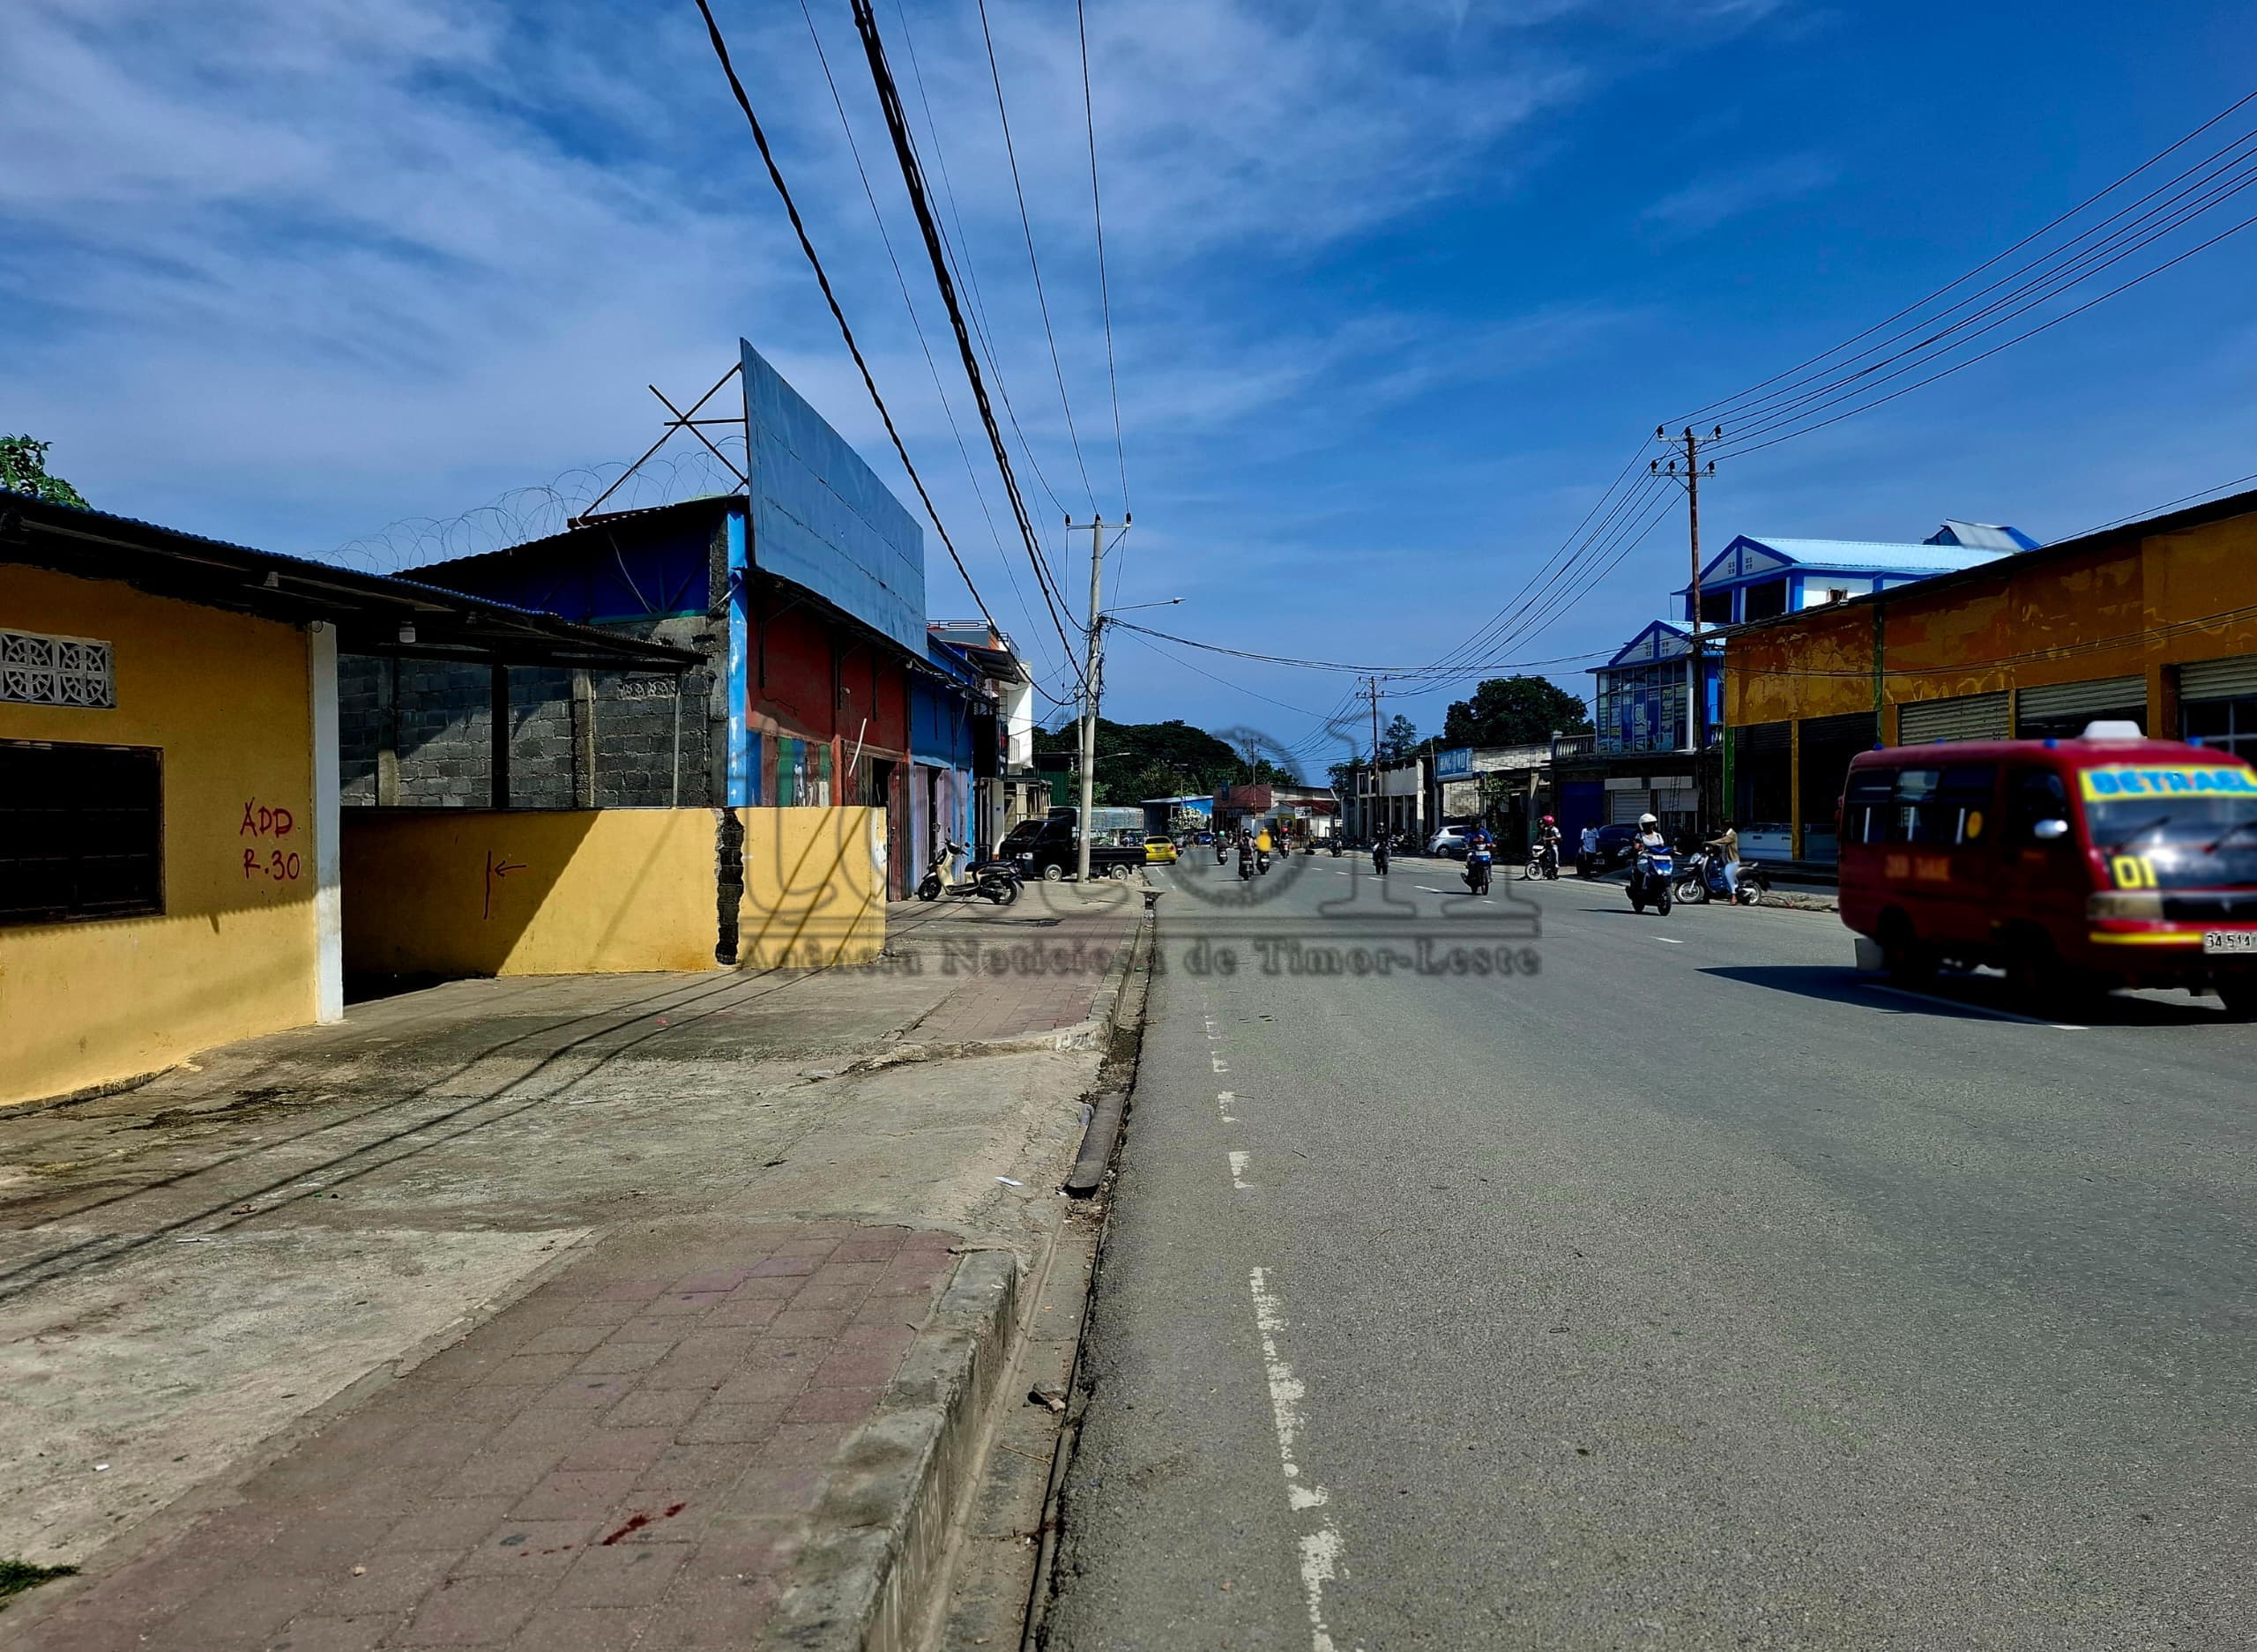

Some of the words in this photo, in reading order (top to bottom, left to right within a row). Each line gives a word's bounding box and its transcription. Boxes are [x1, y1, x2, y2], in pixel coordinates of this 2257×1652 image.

[240, 796, 293, 838] ADD
[243, 848, 300, 881] R.30
[2112, 855, 2157, 889] 01
